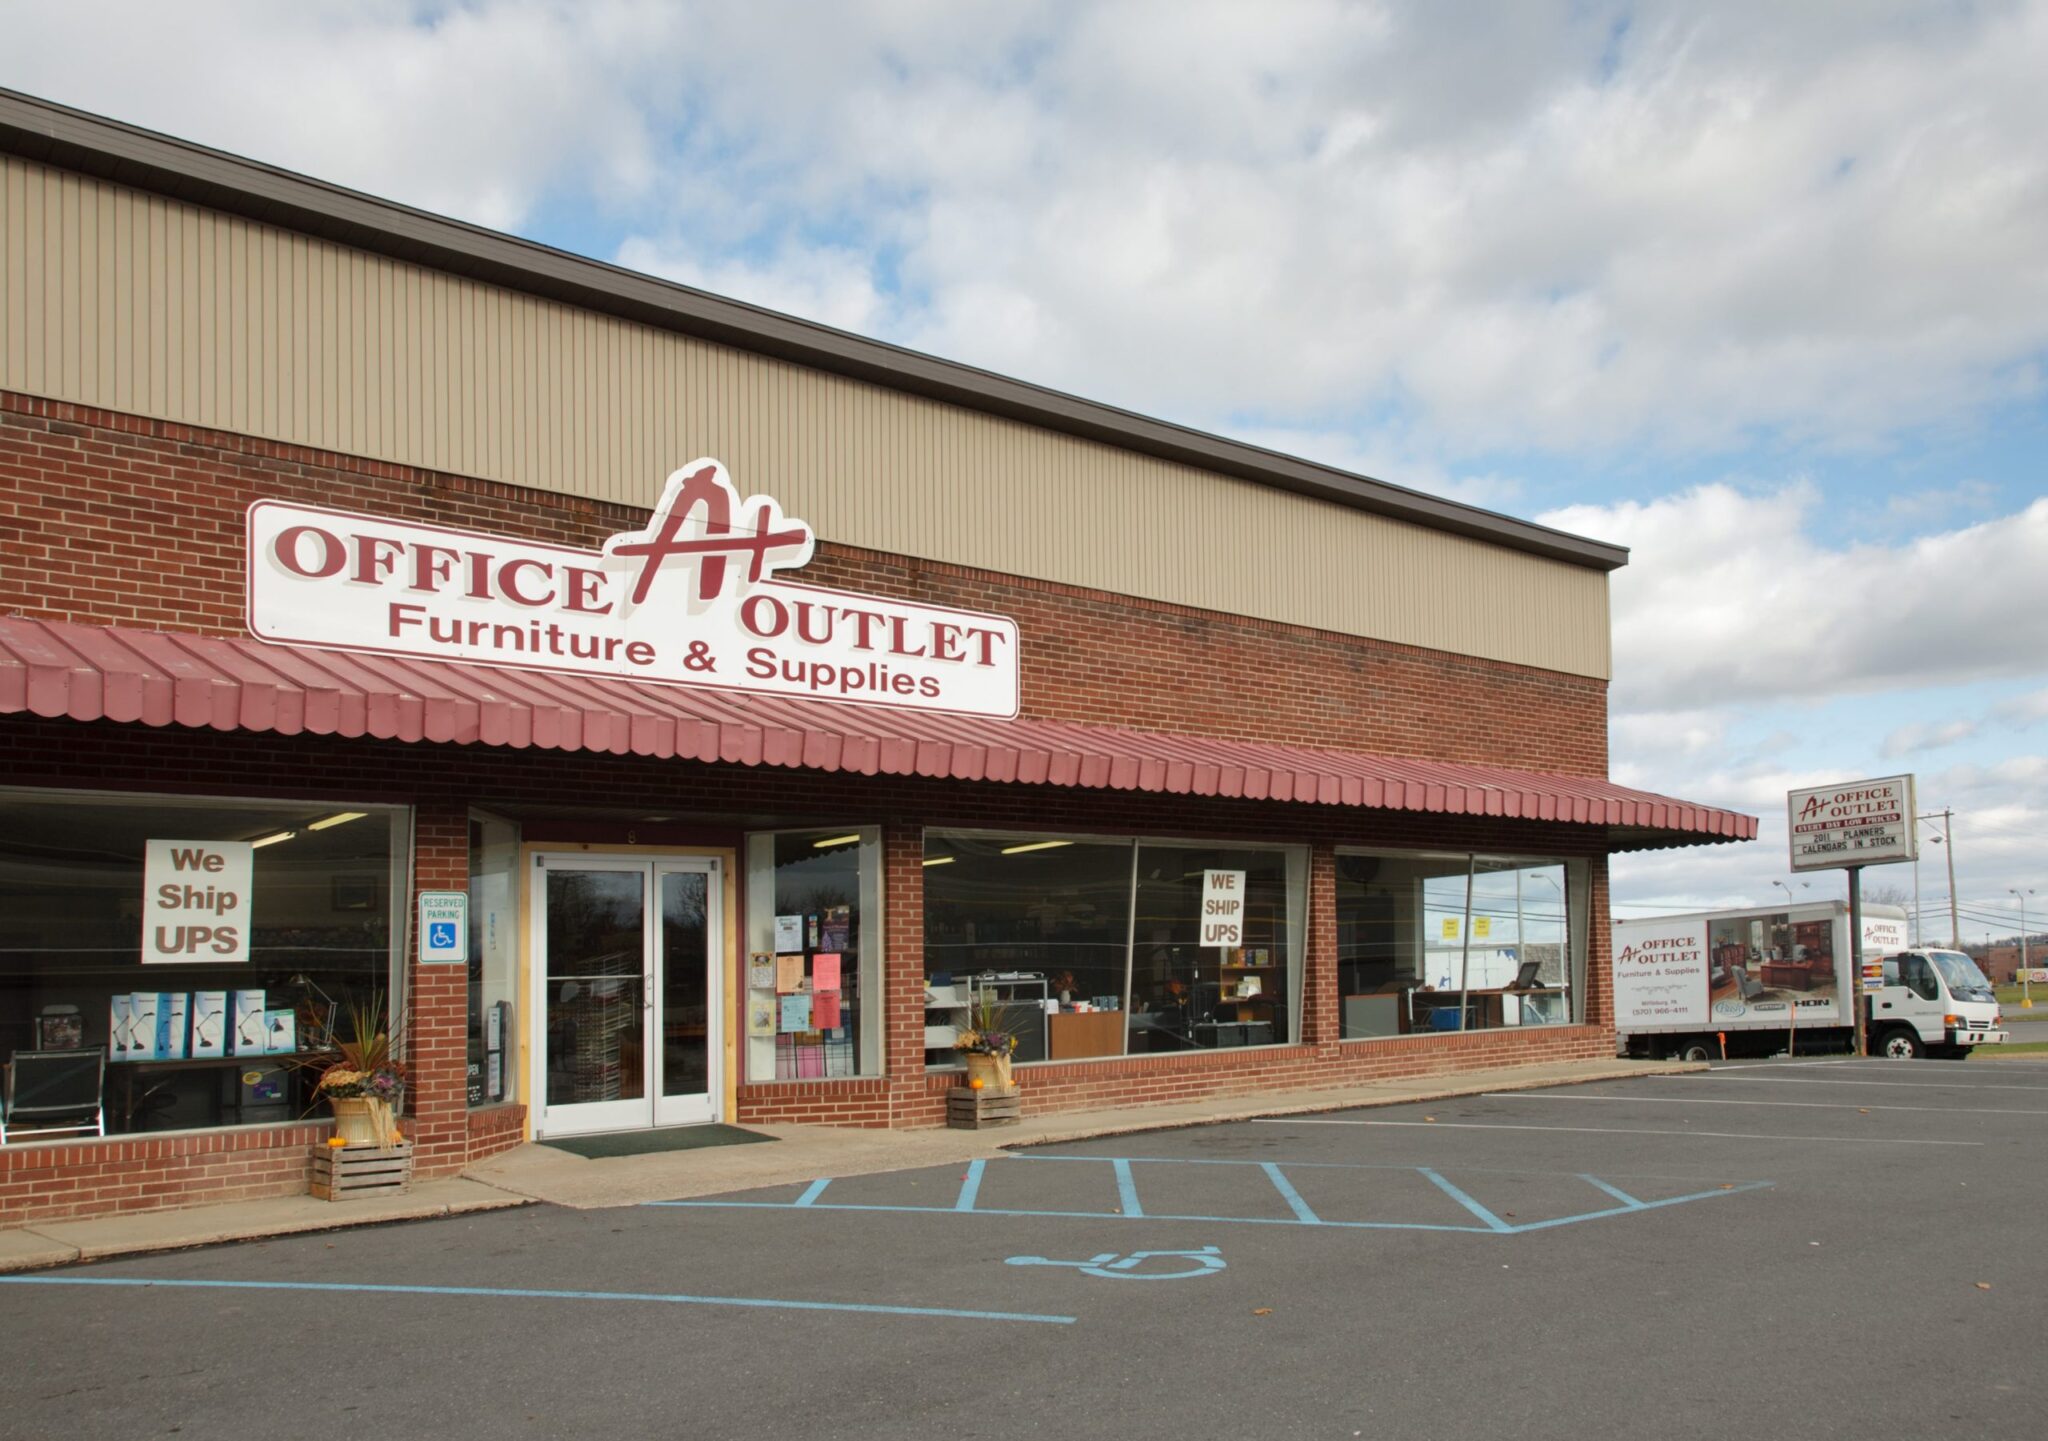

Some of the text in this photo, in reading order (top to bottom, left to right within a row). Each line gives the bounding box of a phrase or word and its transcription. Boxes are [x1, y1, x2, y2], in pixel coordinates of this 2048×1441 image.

[612, 465, 807, 605] A+
[274, 525, 1007, 667] OFFICE OUTLET
[389, 602, 941, 698] Furniture & Supplies
[1799, 787, 1893, 821] A+ OFFICE
[1830, 800, 1898, 817] OUTLET
[1798, 814, 1898, 832] EVERY DAY LOW PRICES
[1814, 827, 1885, 842] 2011 PLANNERS
[1802, 836, 1896, 854] CALENDARS IN STOCK
[170, 848, 225, 873] We
[1211, 873, 1235, 890] WE
[157, 884, 238, 916] Ship
[423, 898, 464, 908] RESERVED
[1205, 899, 1240, 915] SHIP
[427, 910, 460, 920] PARKING
[1205, 924, 1239, 943] UPS
[1874, 924, 1897, 934] OFFICE
[155, 926, 239, 954] UPS
[1642, 937, 1696, 950] OFFICE
[1873, 936, 1899, 945] OUTLET
[1638, 951, 1701, 965] OUTLET
[1617, 970, 1652, 978] Furniture
[1664, 967, 1700, 976] Supplies
[1795, 999, 1830, 1007] HON
